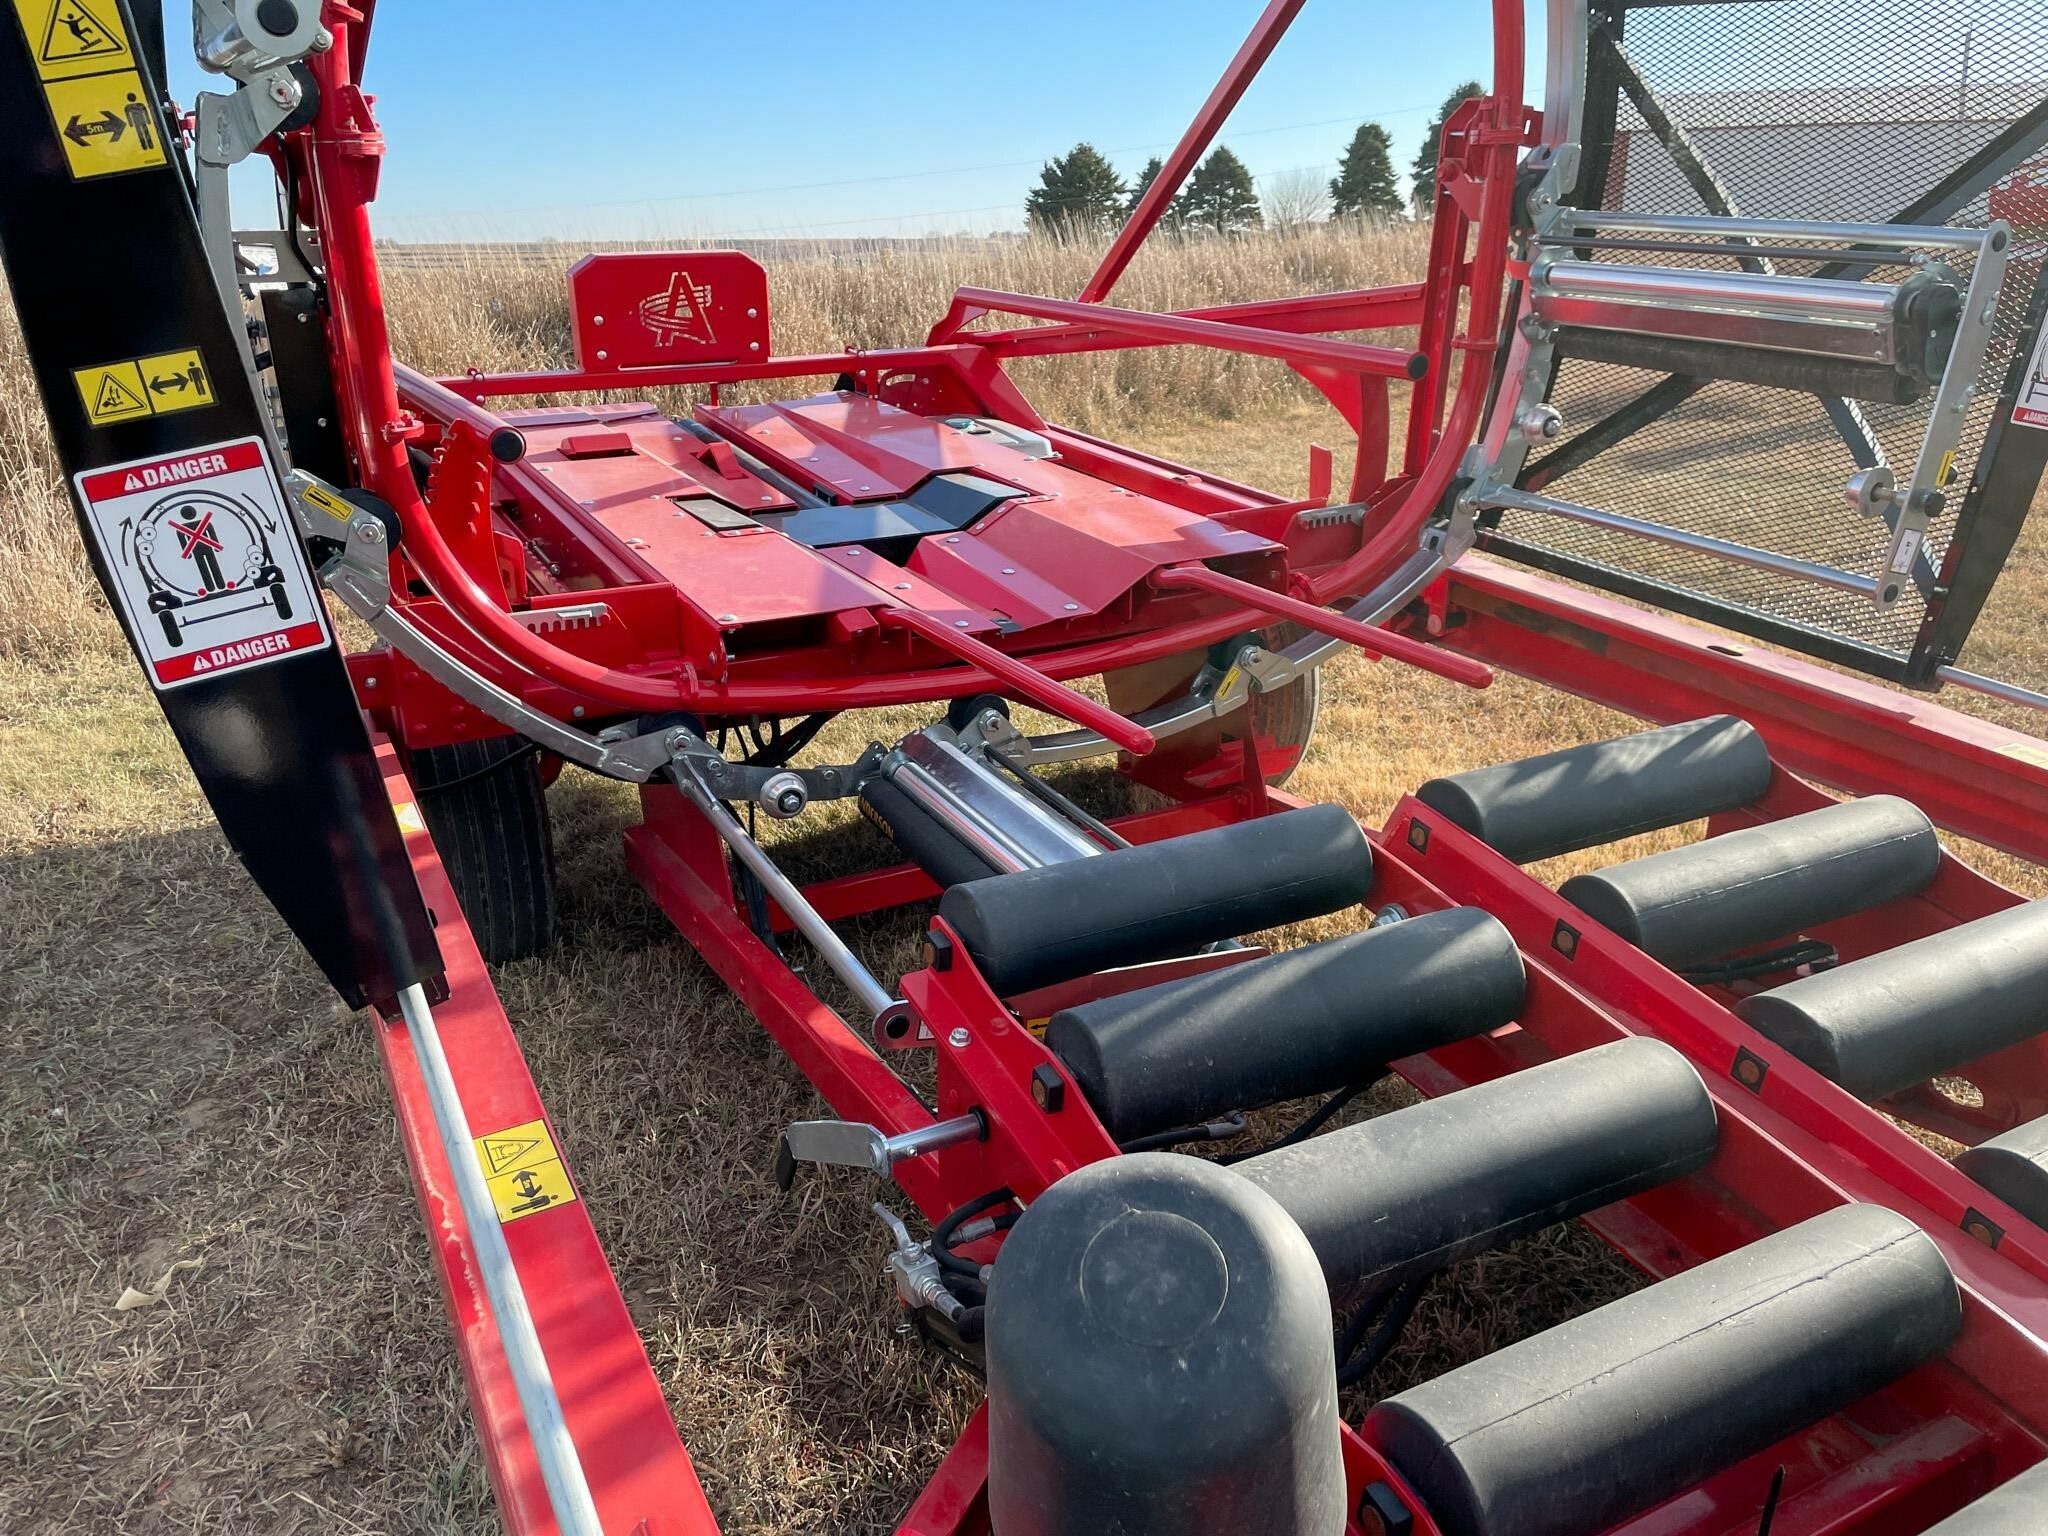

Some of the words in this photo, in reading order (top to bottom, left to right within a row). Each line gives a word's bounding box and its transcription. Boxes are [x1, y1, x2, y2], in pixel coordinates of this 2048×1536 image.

[86, 124, 104, 134] 5m
[2029, 411, 2048, 425] DANGE
[142, 454, 228, 487] DANGER
[210, 633, 291, 667] DANGER
